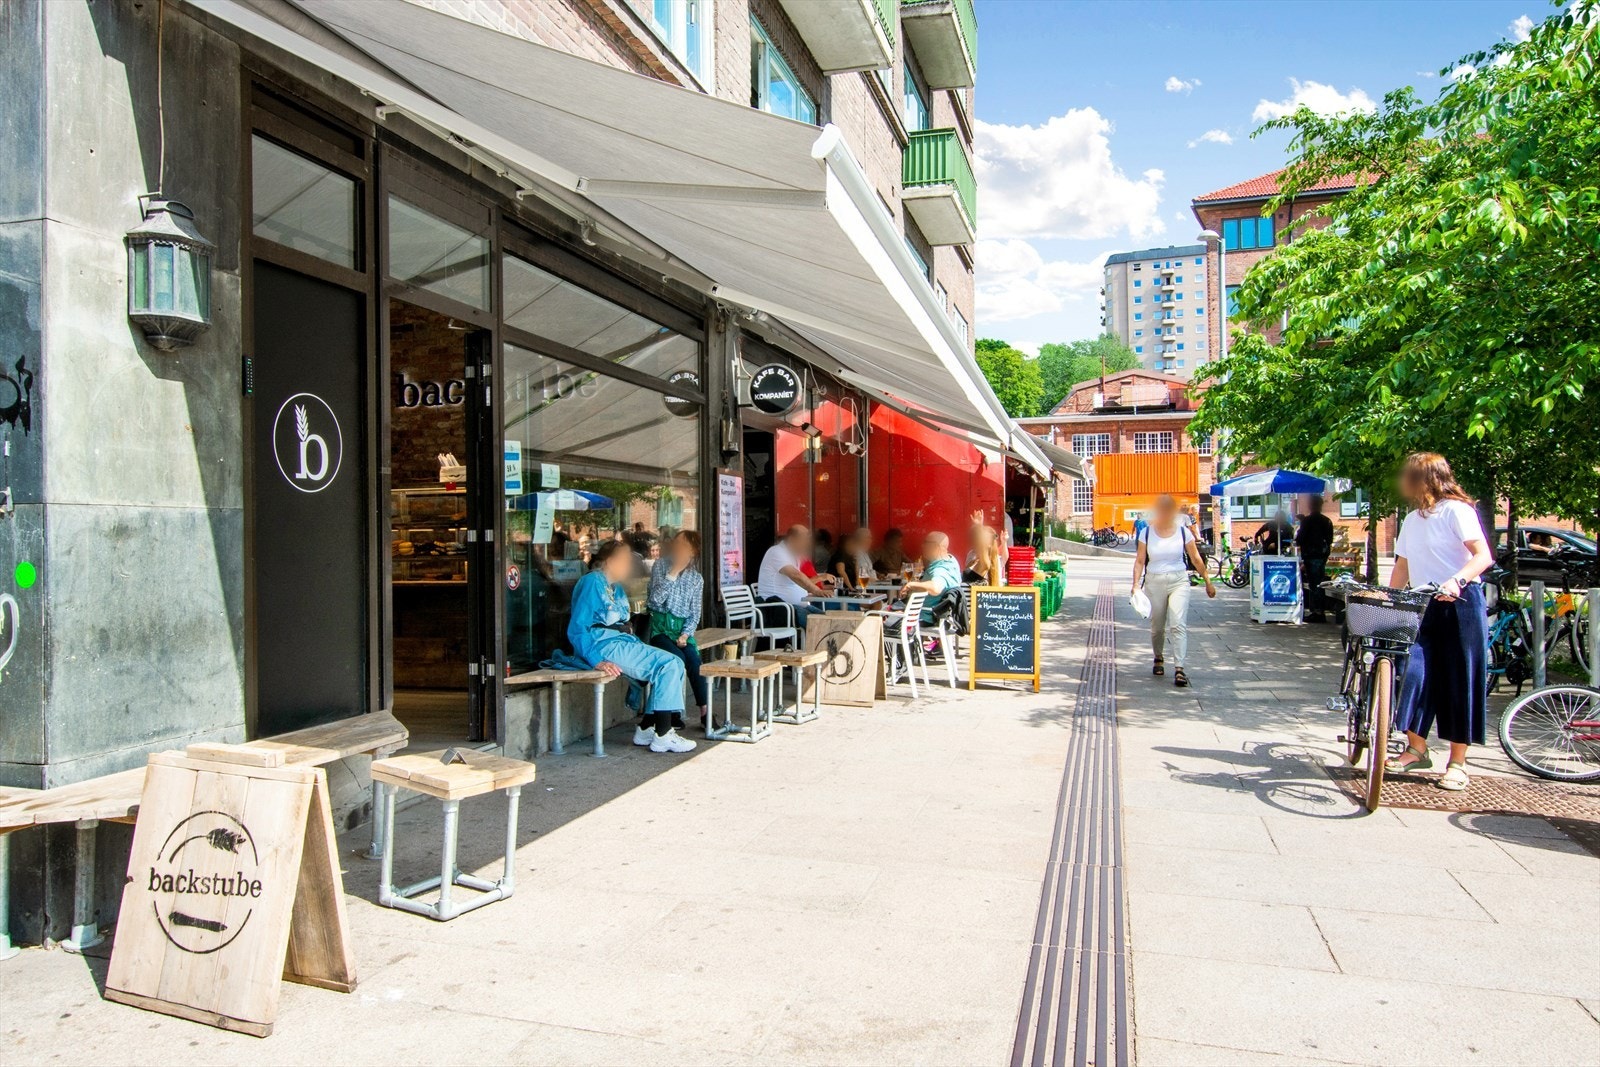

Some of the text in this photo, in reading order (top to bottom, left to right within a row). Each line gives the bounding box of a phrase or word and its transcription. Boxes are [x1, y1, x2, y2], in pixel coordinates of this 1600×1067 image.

[753, 368, 795, 389] KAFE BAR
[147, 866, 262, 899] backstube
